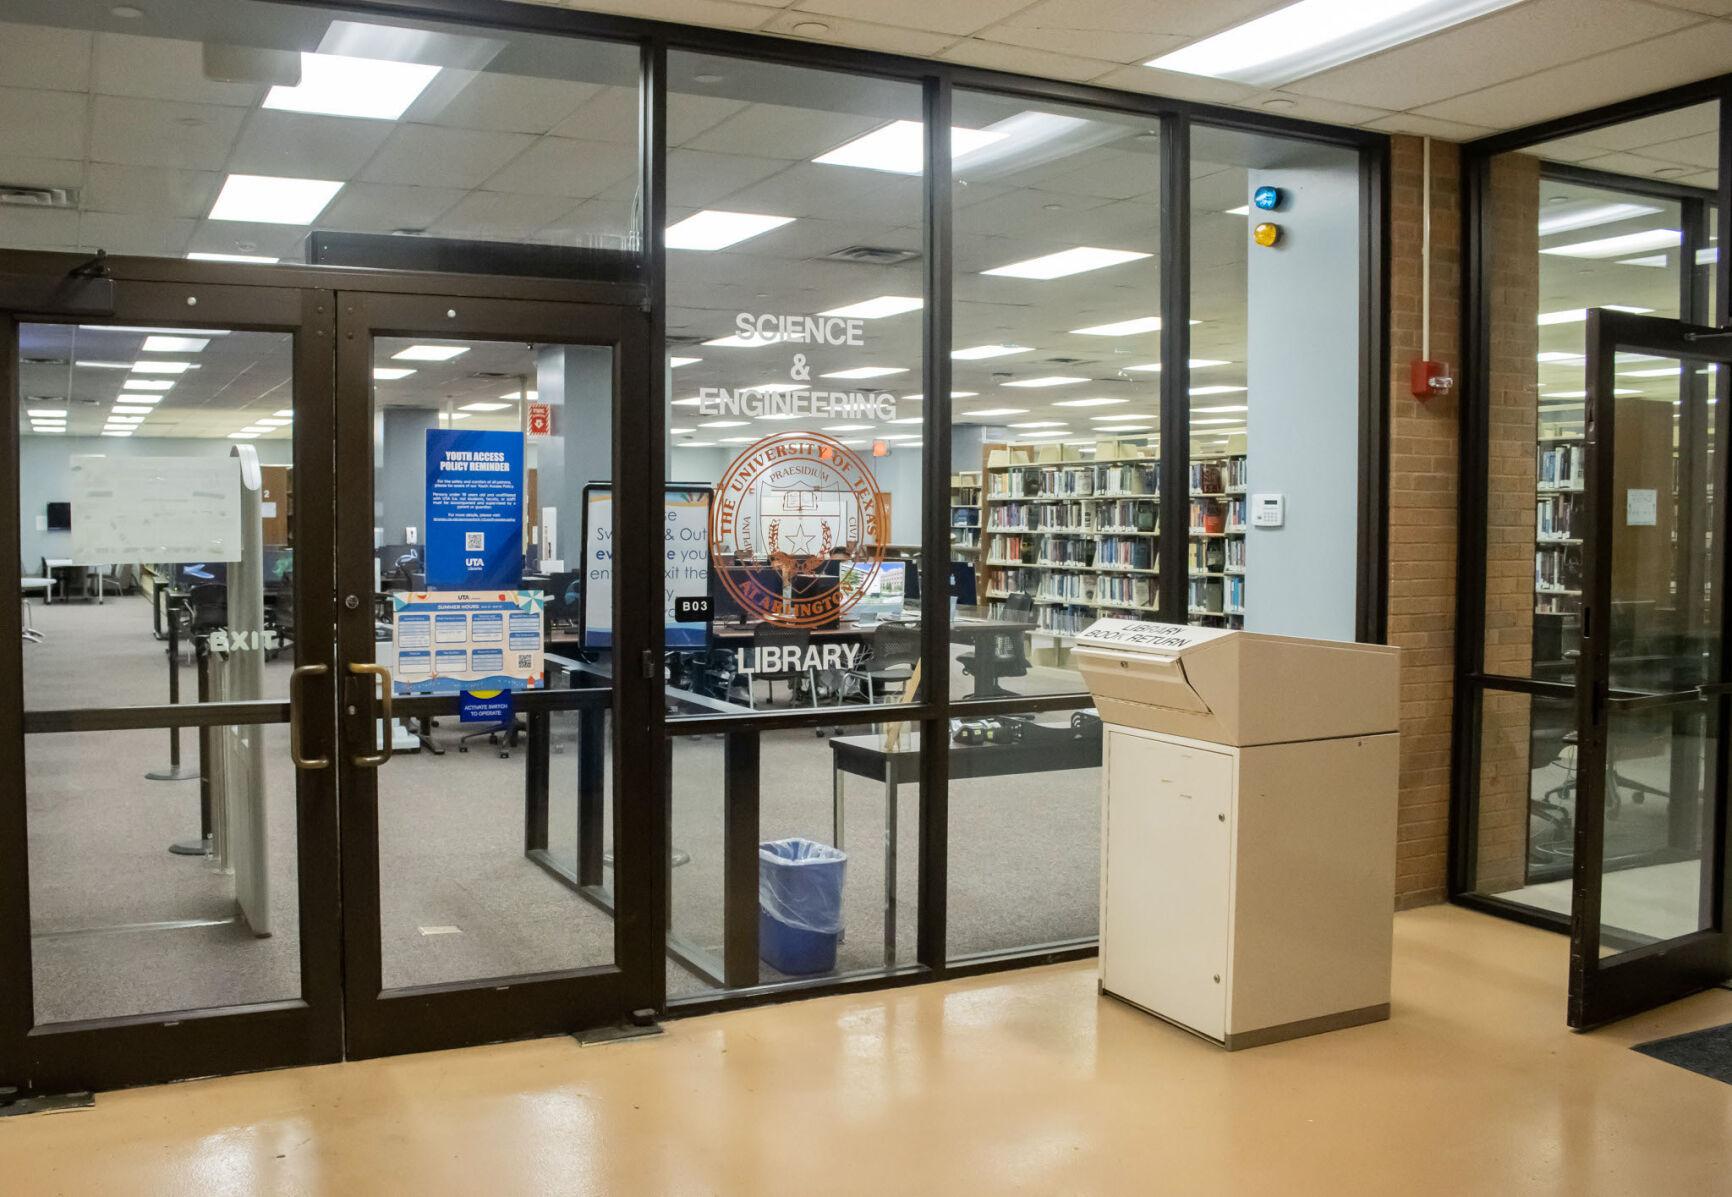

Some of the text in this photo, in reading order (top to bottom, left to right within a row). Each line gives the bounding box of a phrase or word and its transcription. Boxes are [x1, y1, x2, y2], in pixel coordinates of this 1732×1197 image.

[736, 312, 865, 346] SCIENCE
[790, 353, 811, 381] &
[699, 387, 896, 421] ENGINEERING
[446, 452, 504, 462] YOUTH ACCESS
[440, 461, 509, 472] POLICY REMINDER
[769, 465, 829, 482] PRAESIDIUM
[721, 443, 878, 536] THE UNIVERSITY OF TEXAS
[680, 528, 708, 541] Out
[465, 558, 485, 567] UTA
[680, 550, 707, 563] you
[664, 567, 708, 580] xit the
[682, 601, 708, 612] B03
[759, 580, 854, 617] ARLINGTON
[1085, 630, 1192, 647] BOOK RETURN
[1122, 624, 1185, 636] LIBRARY
[209, 630, 277, 652] EXIT
[737, 643, 860, 674] LIBRARY
